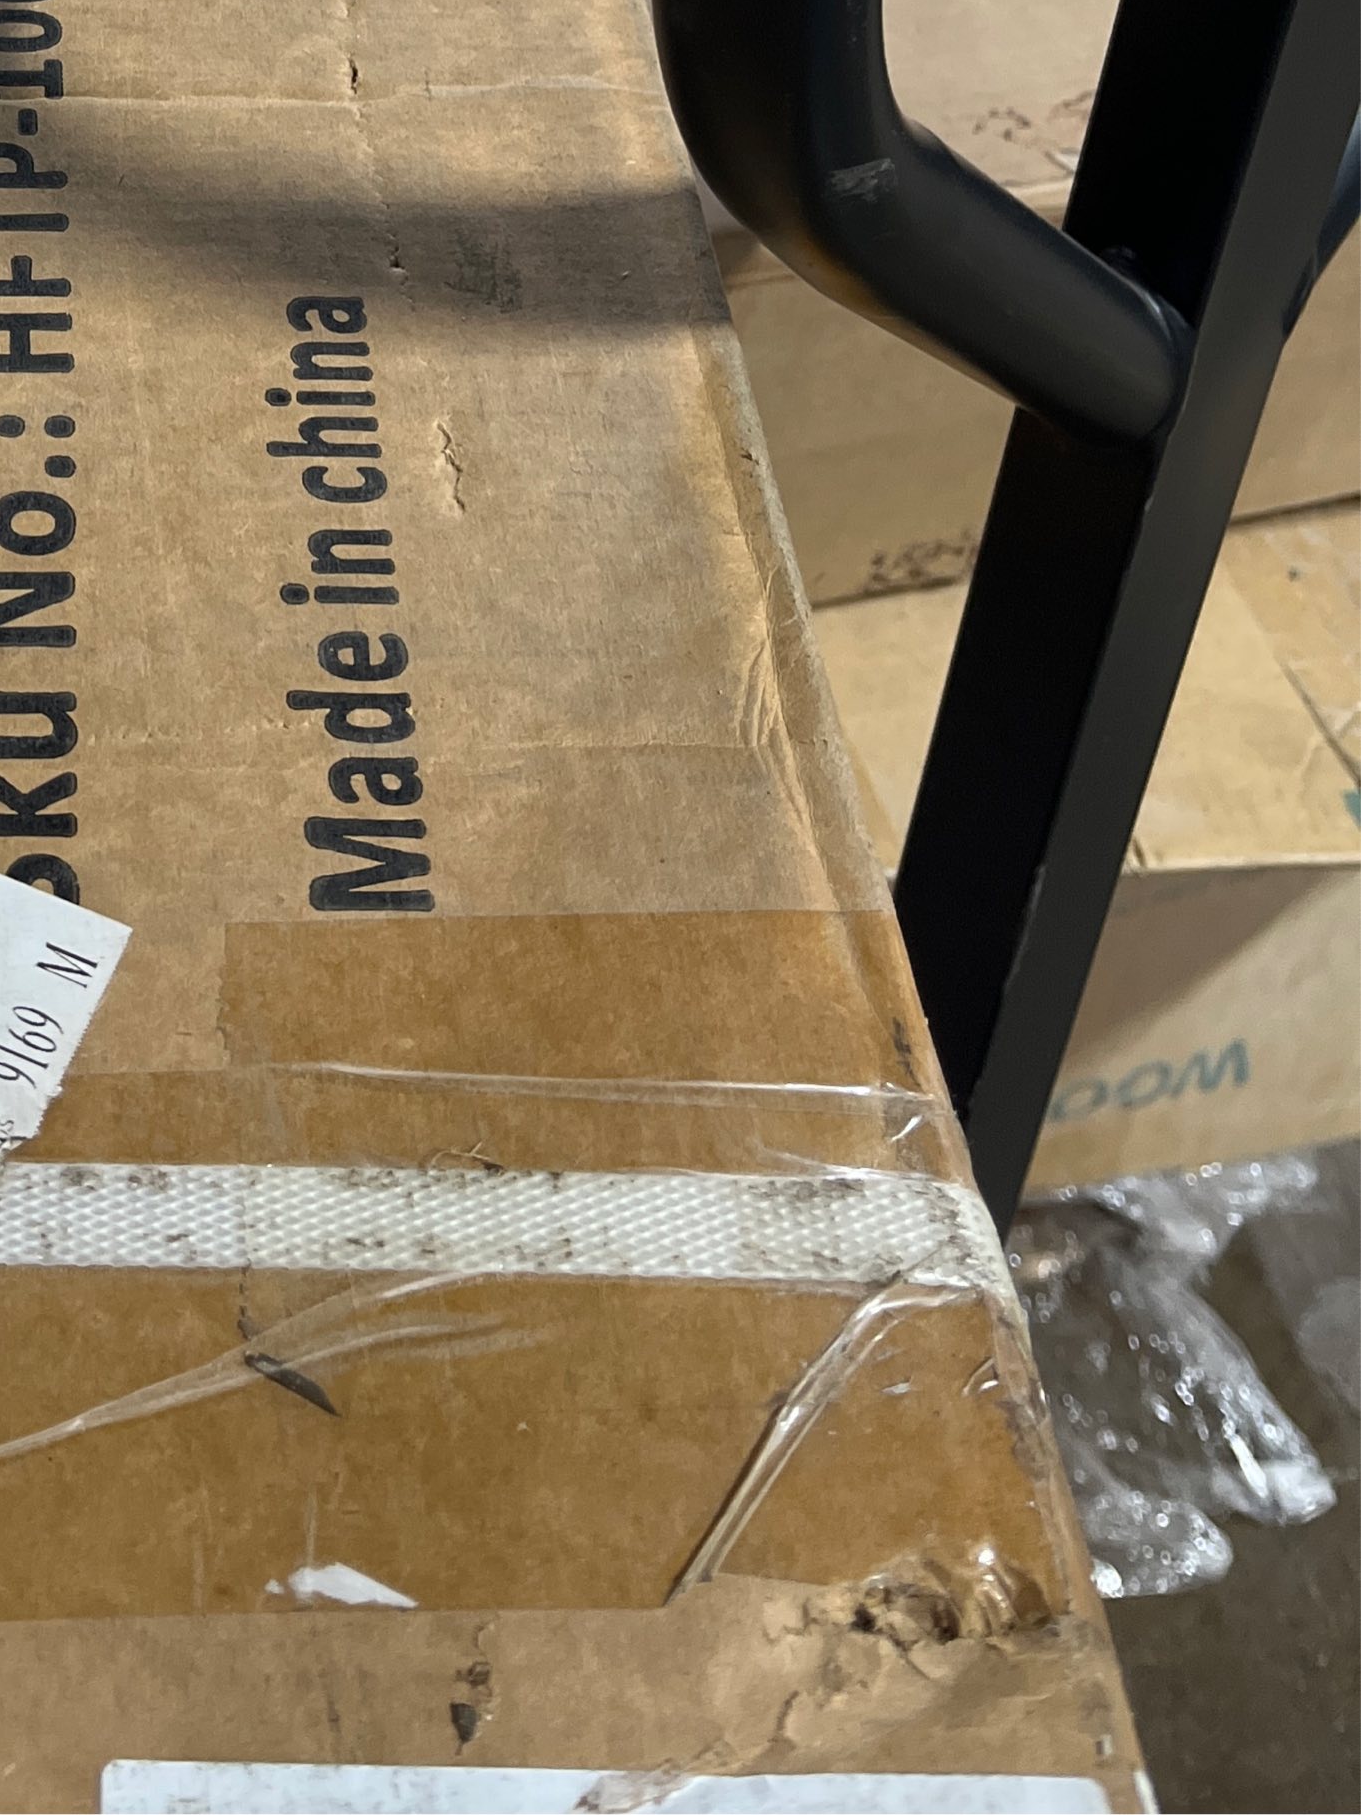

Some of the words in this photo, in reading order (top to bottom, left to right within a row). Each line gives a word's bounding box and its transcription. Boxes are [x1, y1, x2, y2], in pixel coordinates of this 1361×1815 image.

[264, 295, 388, 503] china
[279, 529, 399, 605] in
[285, 631, 435, 912] Made
[34, 941, 99, 992] M
